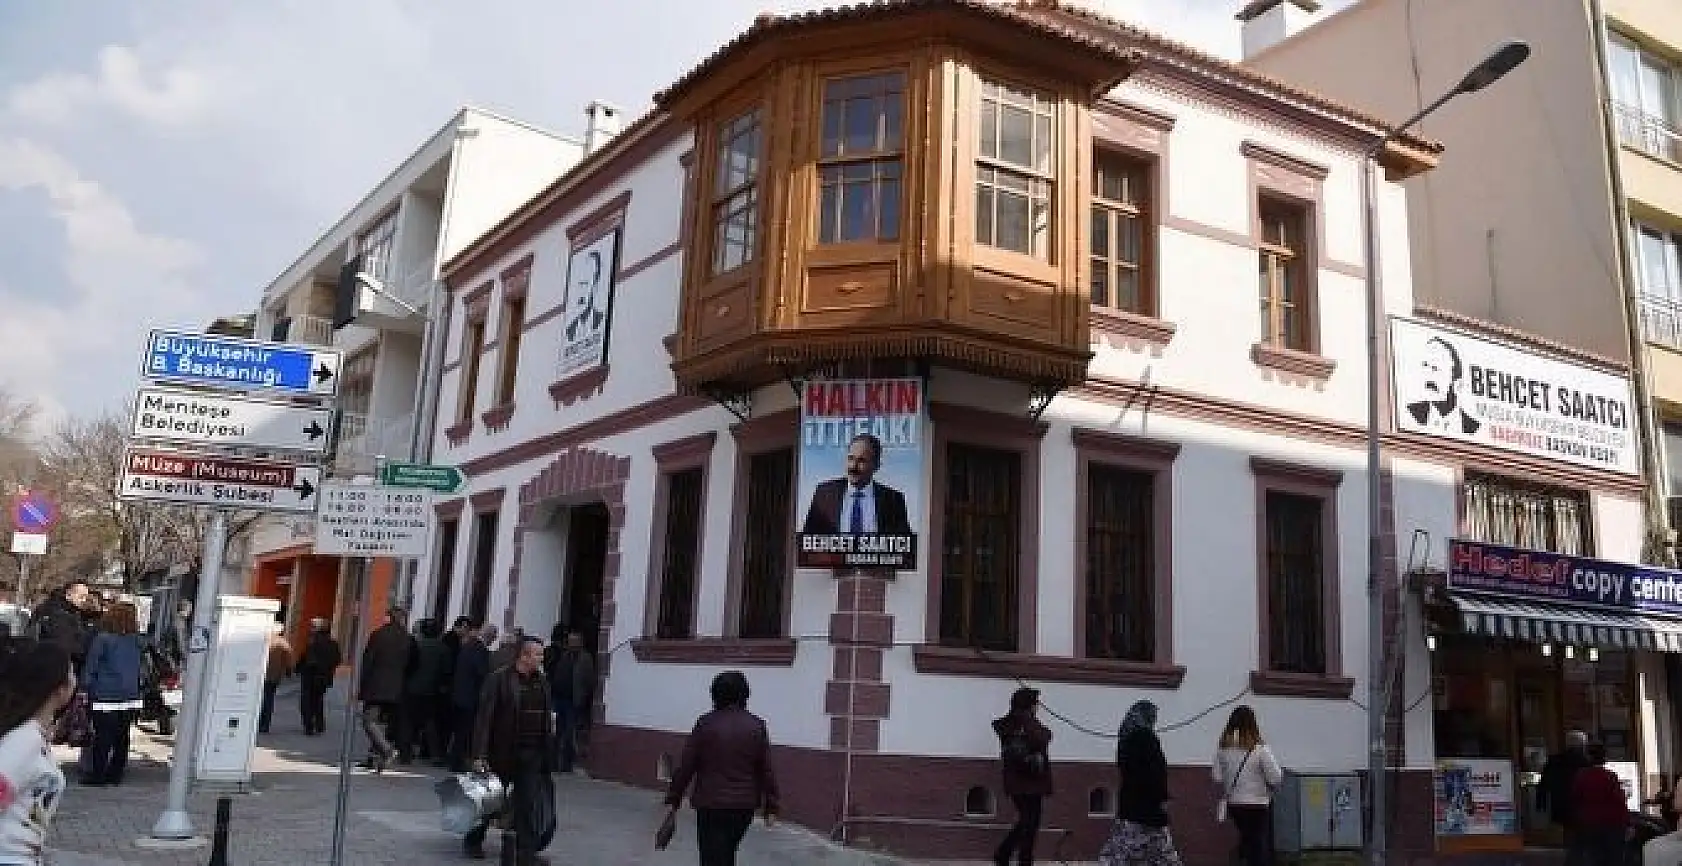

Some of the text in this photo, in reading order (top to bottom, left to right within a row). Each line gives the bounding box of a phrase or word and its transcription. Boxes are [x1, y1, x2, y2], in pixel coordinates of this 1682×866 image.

[806, 381, 918, 416] HALKIN
[1470, 365, 1550, 411] BEHÇET
[144, 396, 230, 418] Menteşe
[142, 414, 245, 437] Belediyesi
[132, 454, 186, 472] Müze
[129, 478, 275, 502] Askerlik Şubesi
[1453, 545, 1570, 585] Hedef
[1572, 569, 1625, 604] copy
